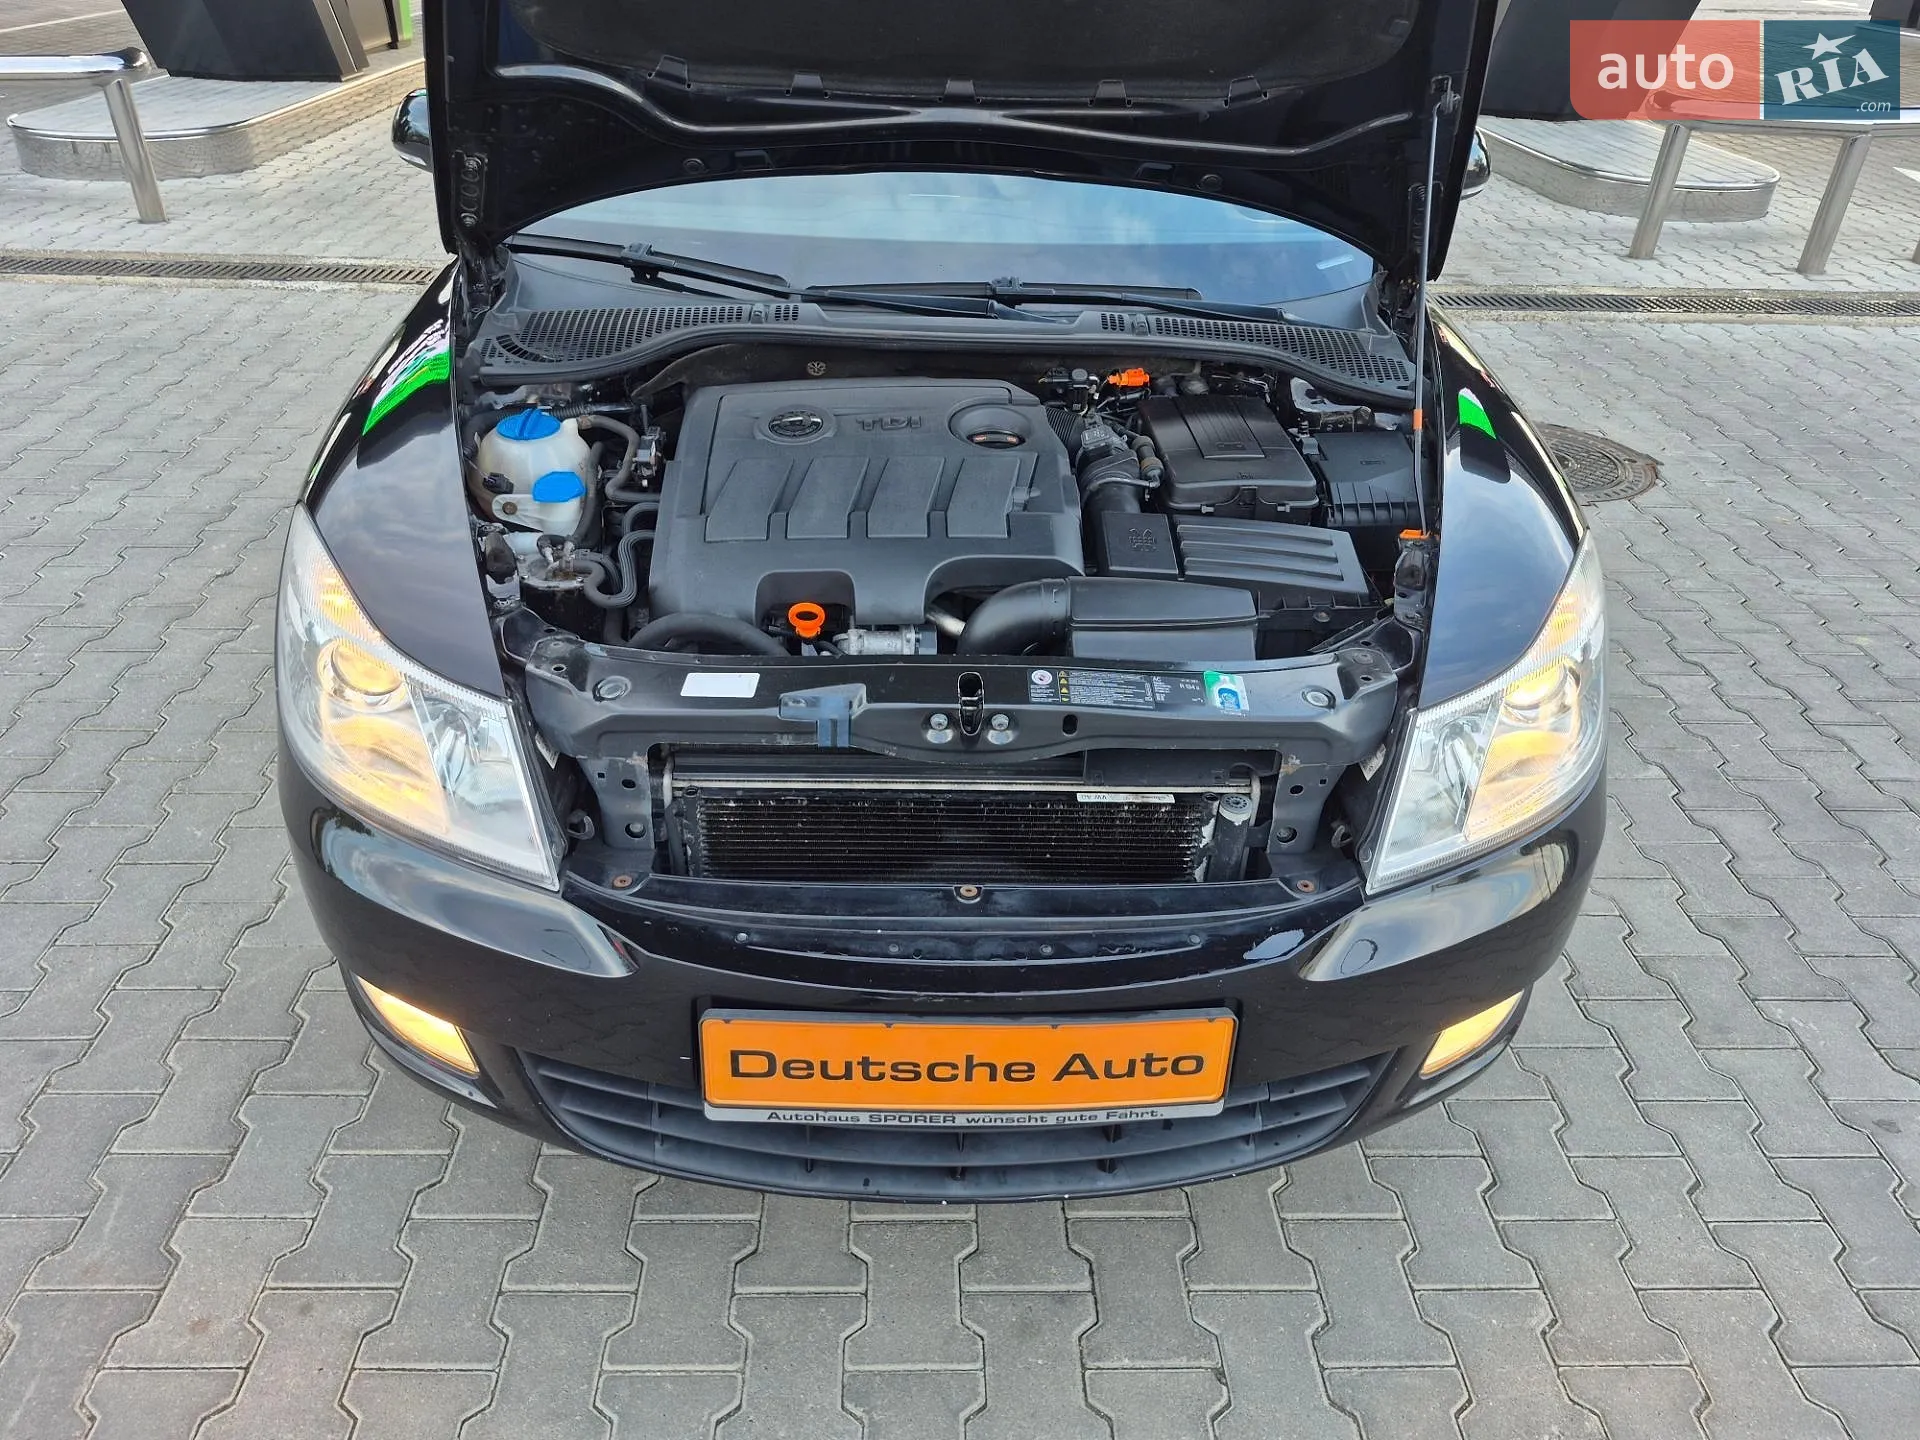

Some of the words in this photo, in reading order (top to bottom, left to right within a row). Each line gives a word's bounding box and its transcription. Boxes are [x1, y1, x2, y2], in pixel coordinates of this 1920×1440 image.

[856, 415, 922, 431] TDI
[730, 1050, 1036, 1083] Deutsche
[1052, 1052, 1205, 1082] Auto
[767, 1111, 860, 1123] Autohaus
[868, 1114, 956, 1124] SPORER
[966, 1114, 1048, 1124] wünscht
[1055, 1113, 1098, 1124] gute
[1105, 1109, 1164, 1120] Fahrt.
